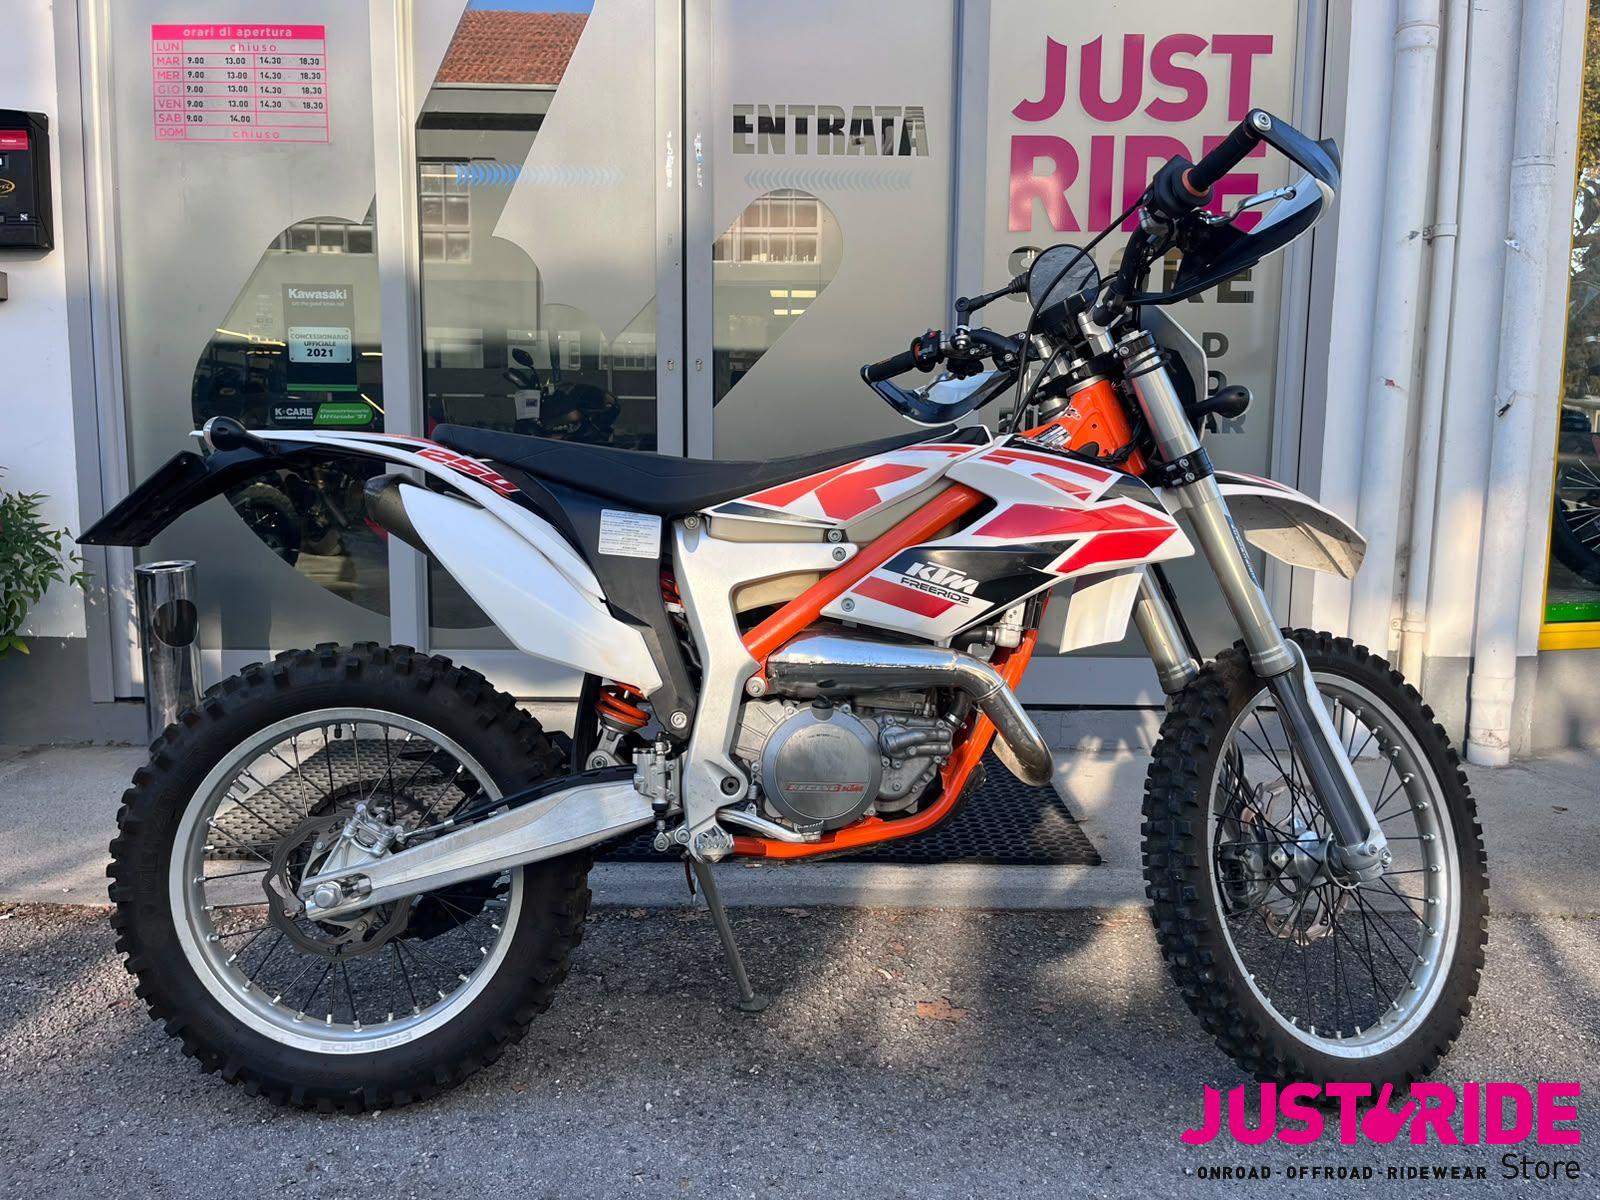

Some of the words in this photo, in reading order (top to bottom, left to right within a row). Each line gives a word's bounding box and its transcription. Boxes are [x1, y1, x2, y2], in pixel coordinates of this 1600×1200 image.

[183, 27, 214, 38] orari
[219, 27, 231, 38] di
[236, 27, 293, 40] apertura
[156, 42, 180, 51] LUN
[230, 42, 277, 52] chiuso
[156, 57, 180, 66] MAR
[187, 57, 204, 65] 9.00
[225, 57, 246, 65] 13.00
[259, 56, 282, 65] 14.30
[299, 57, 320, 66] 18.30
[157, 71, 180, 80] MER
[187, 71, 205, 79] 9.00
[227, 72, 248, 80] 13.00
[260, 72, 282, 80] 14.30
[300, 72, 321, 80] 18.30
[1011, 34, 1273, 122] JUST
[158, 85, 180, 94] GIO
[186, 85, 204, 94] 9.00
[227, 85, 248, 93] 13.00
[260, 86, 282, 95] 14.30
[301, 86, 322, 95] 18.30
[158, 100, 181, 109] VEN
[186, 100, 204, 109] 9.00
[228, 100, 249, 108] 13.00
[260, 100, 282, 109] 14.30
[302, 101, 323, 110] 18.30
[158, 114, 182, 123] SAB
[186, 115, 203, 123] 9.00
[230, 115, 251, 123] 14.00
[159, 128, 184, 137] DOM
[232, 129, 280, 139] chiuso
[733, 104, 929, 156] ENTRATA
[288, 288, 347, 300] Kawasaki
[306, 348, 333, 358] 2021
[904, 561, 980, 595] KTM
[900, 577, 971, 605] FREERIDE
